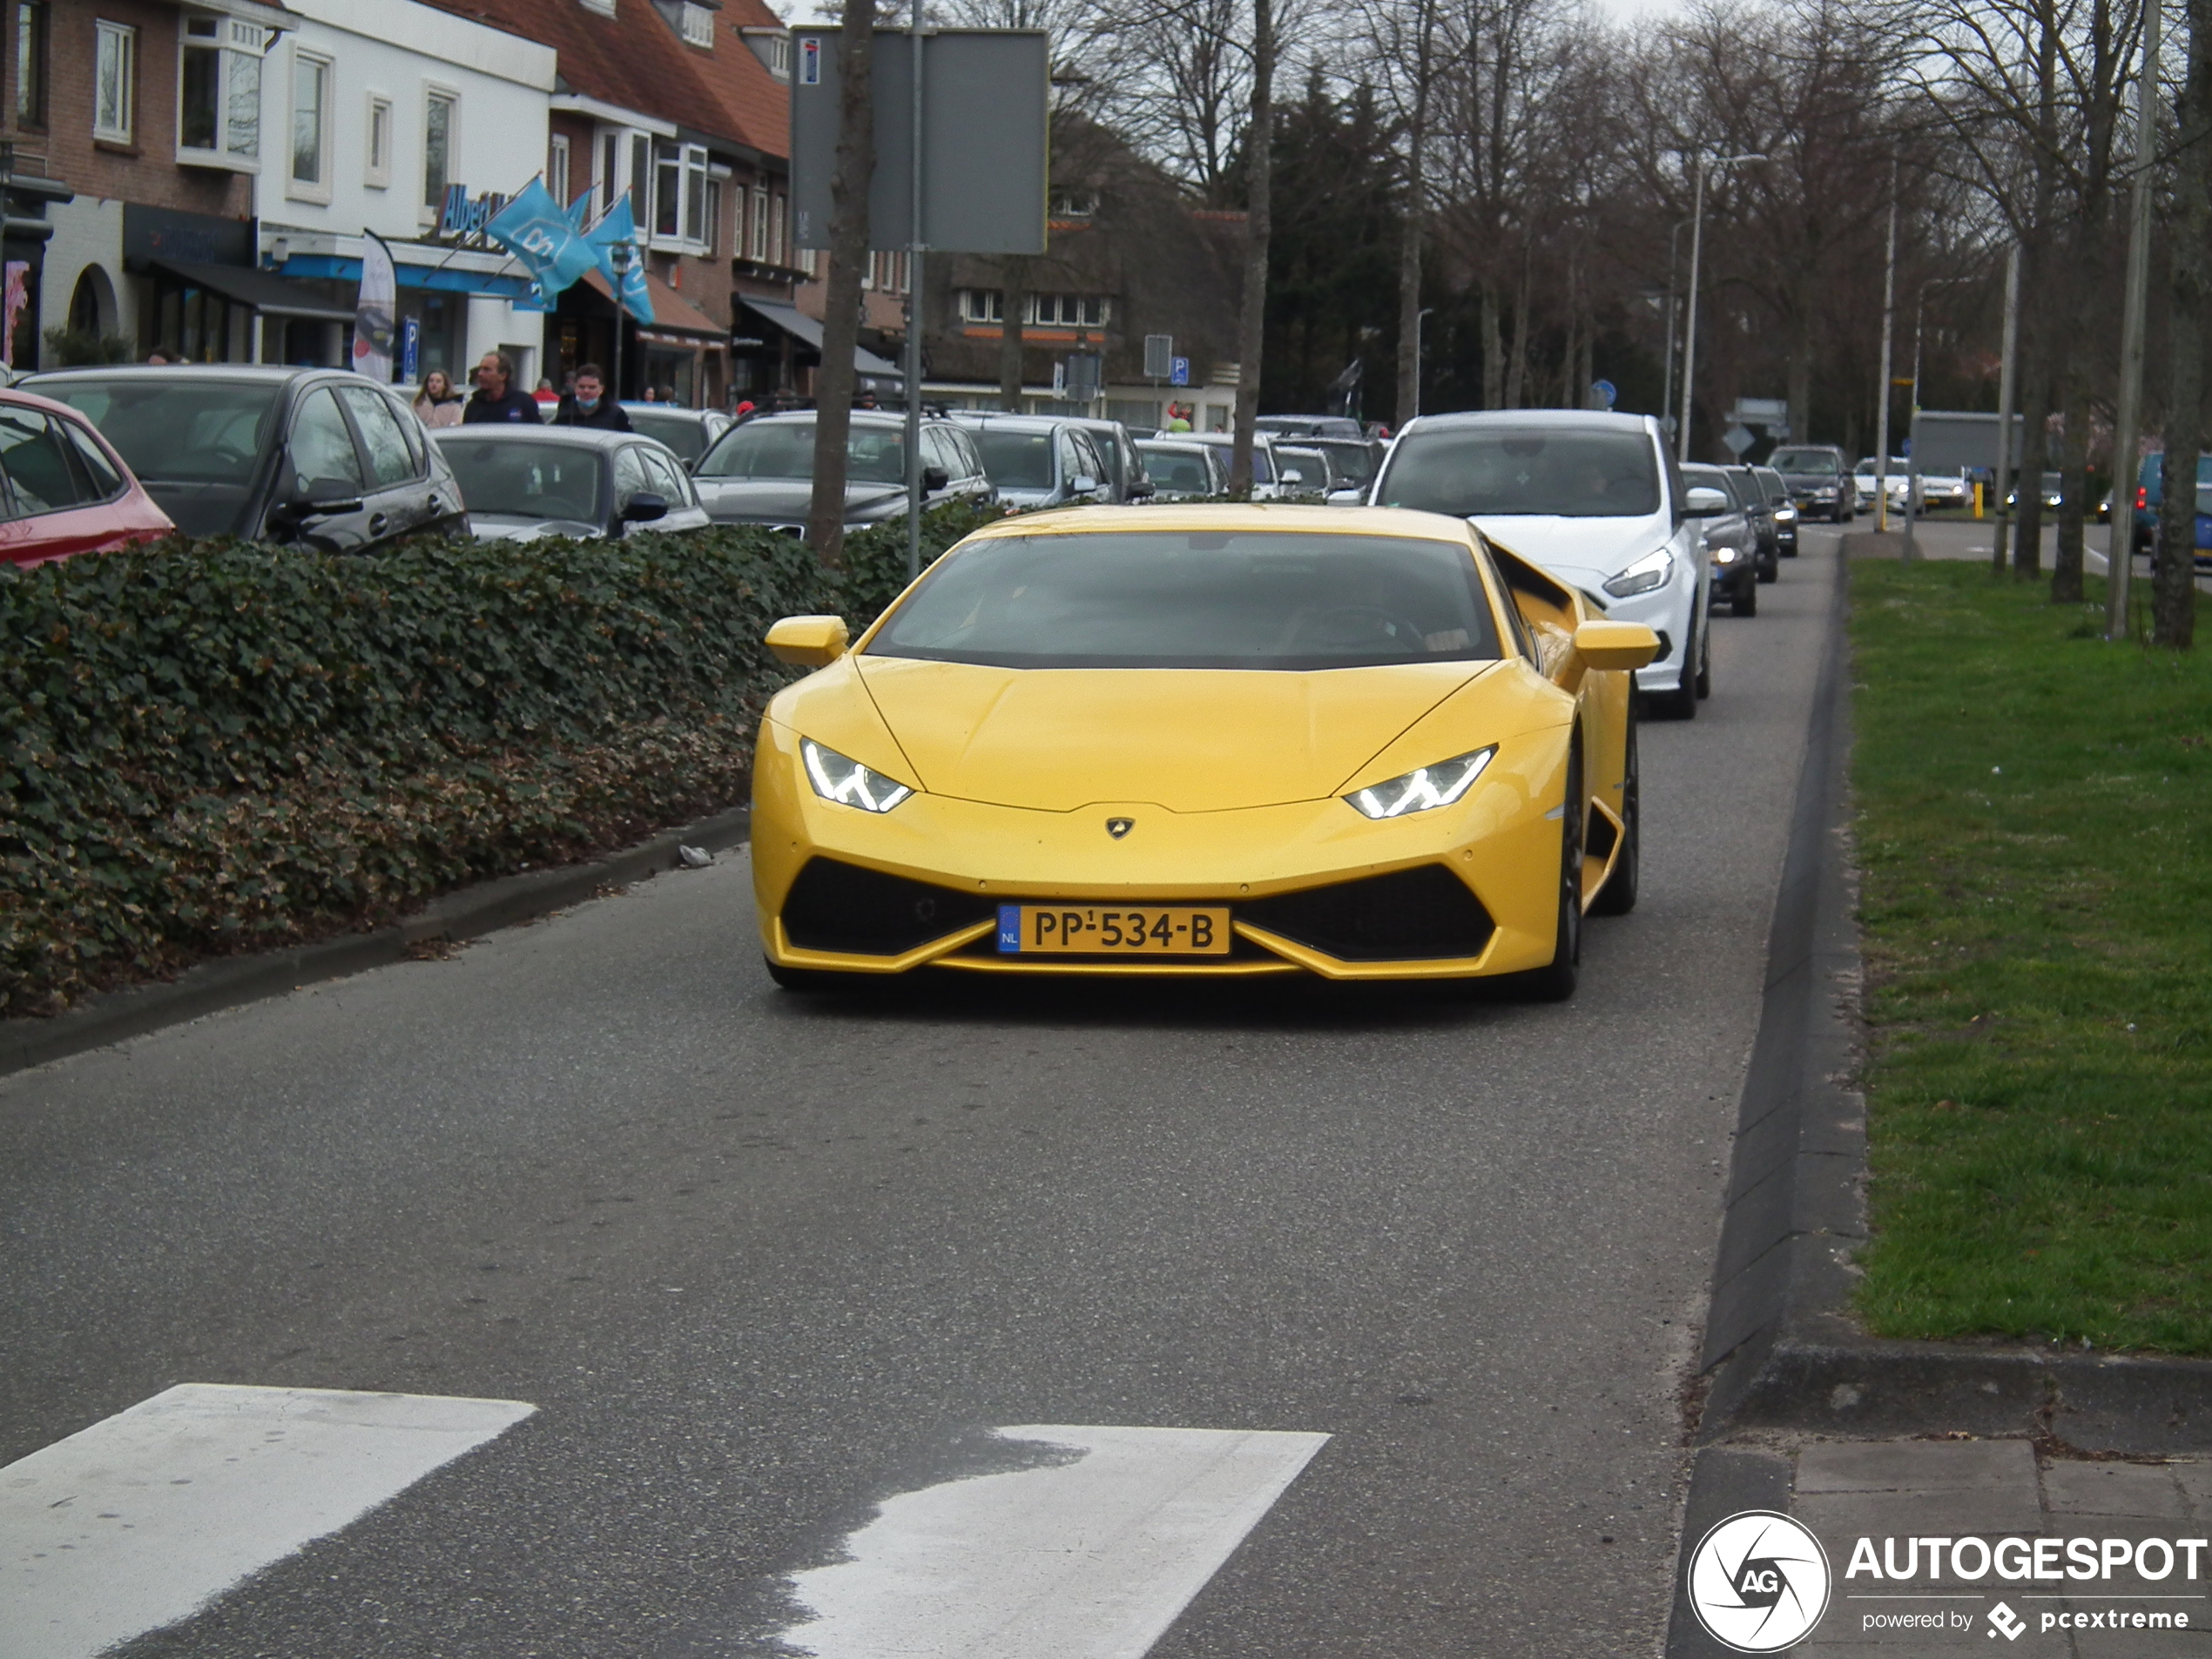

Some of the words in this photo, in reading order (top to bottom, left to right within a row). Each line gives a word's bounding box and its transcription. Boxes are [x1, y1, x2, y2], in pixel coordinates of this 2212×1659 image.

[408, 325, 416, 351] P
[1175, 360, 1184, 373] P
[1001, 934, 1017, 944] NL
